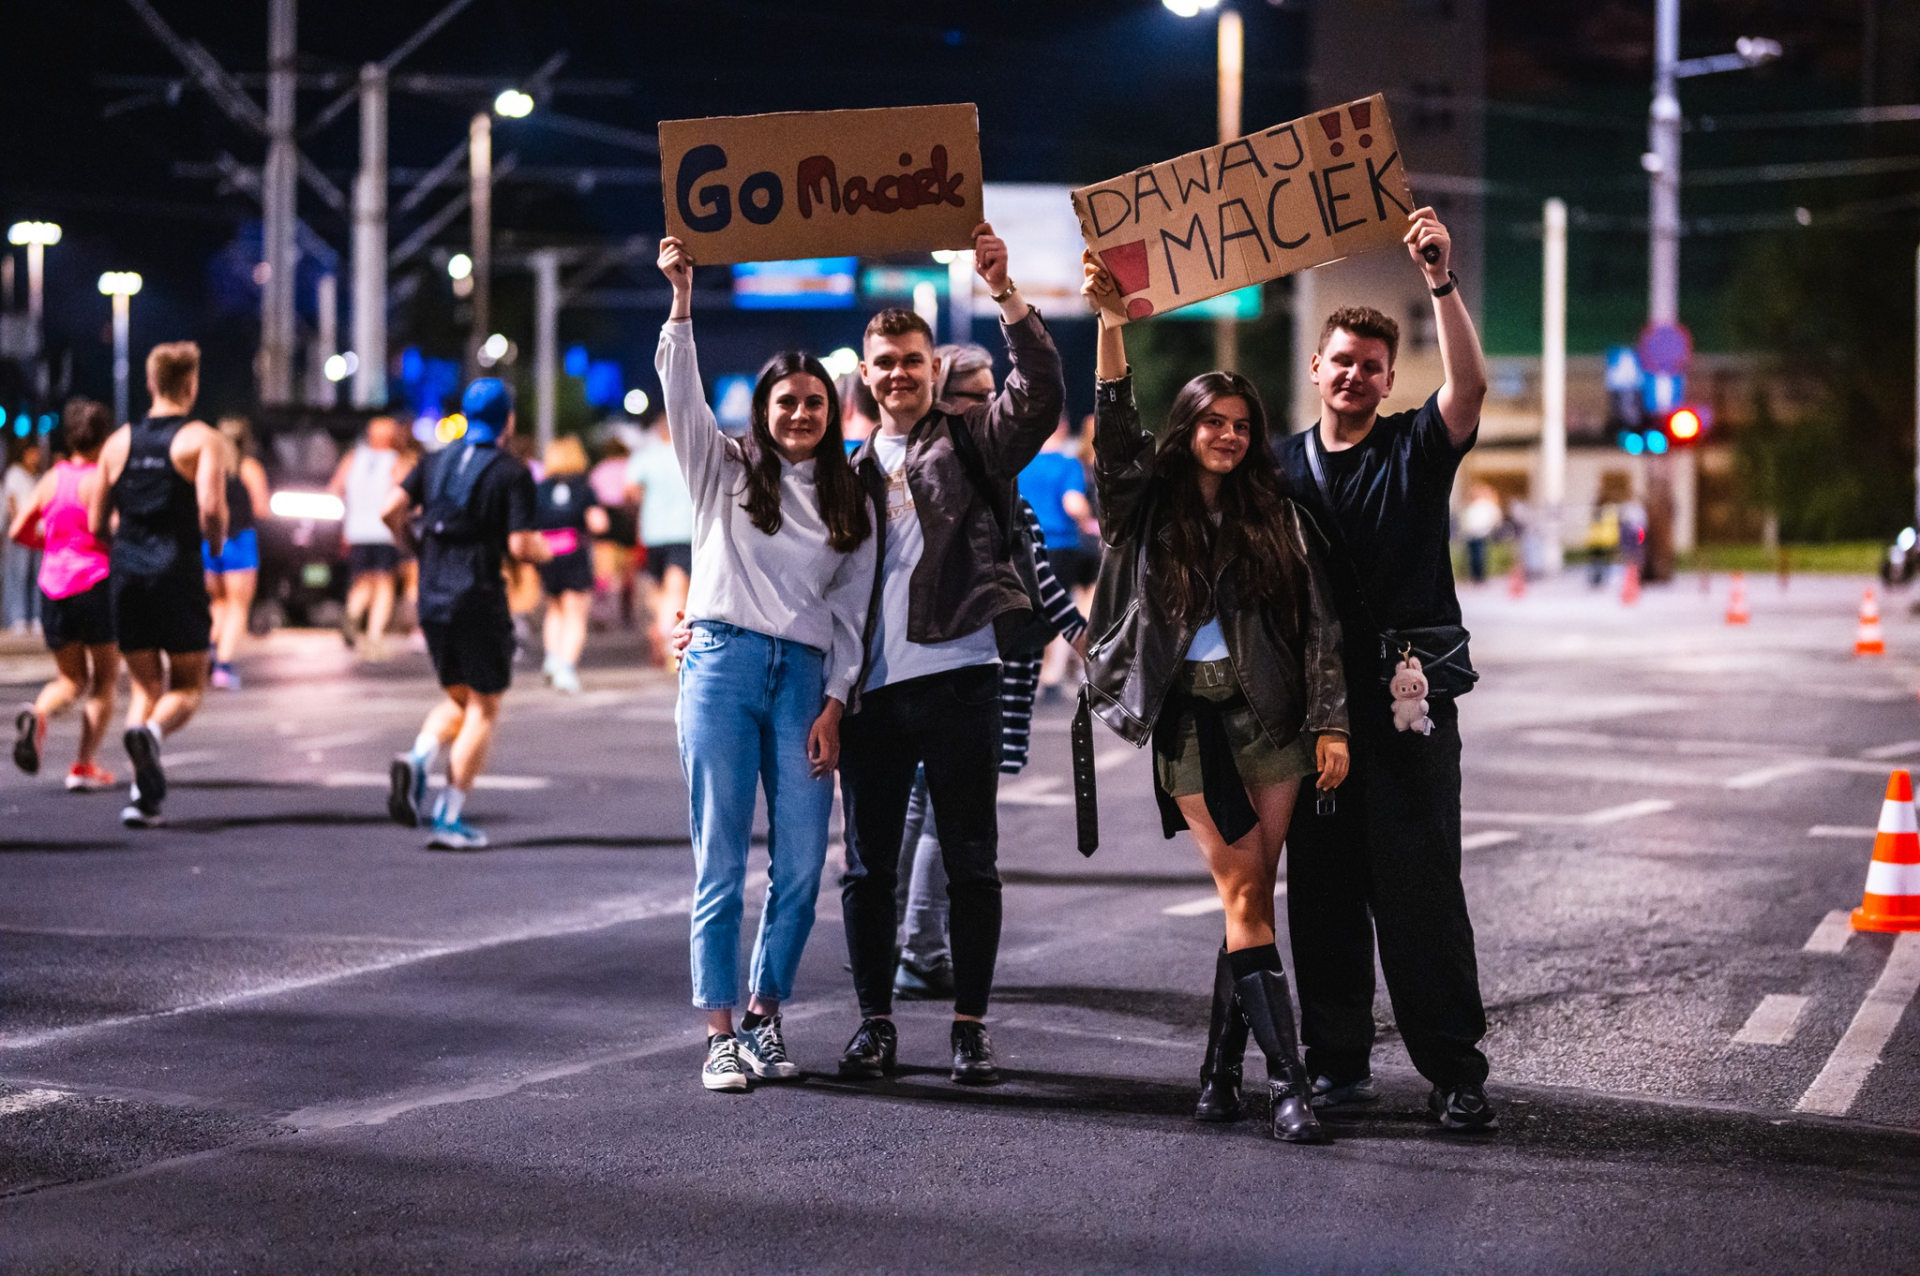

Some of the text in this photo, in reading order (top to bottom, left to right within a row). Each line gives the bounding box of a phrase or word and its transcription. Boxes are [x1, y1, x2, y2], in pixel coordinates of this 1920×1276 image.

[676, 144, 965, 233] Go Maciek
[1159, 151, 1411, 295] MACIEK
